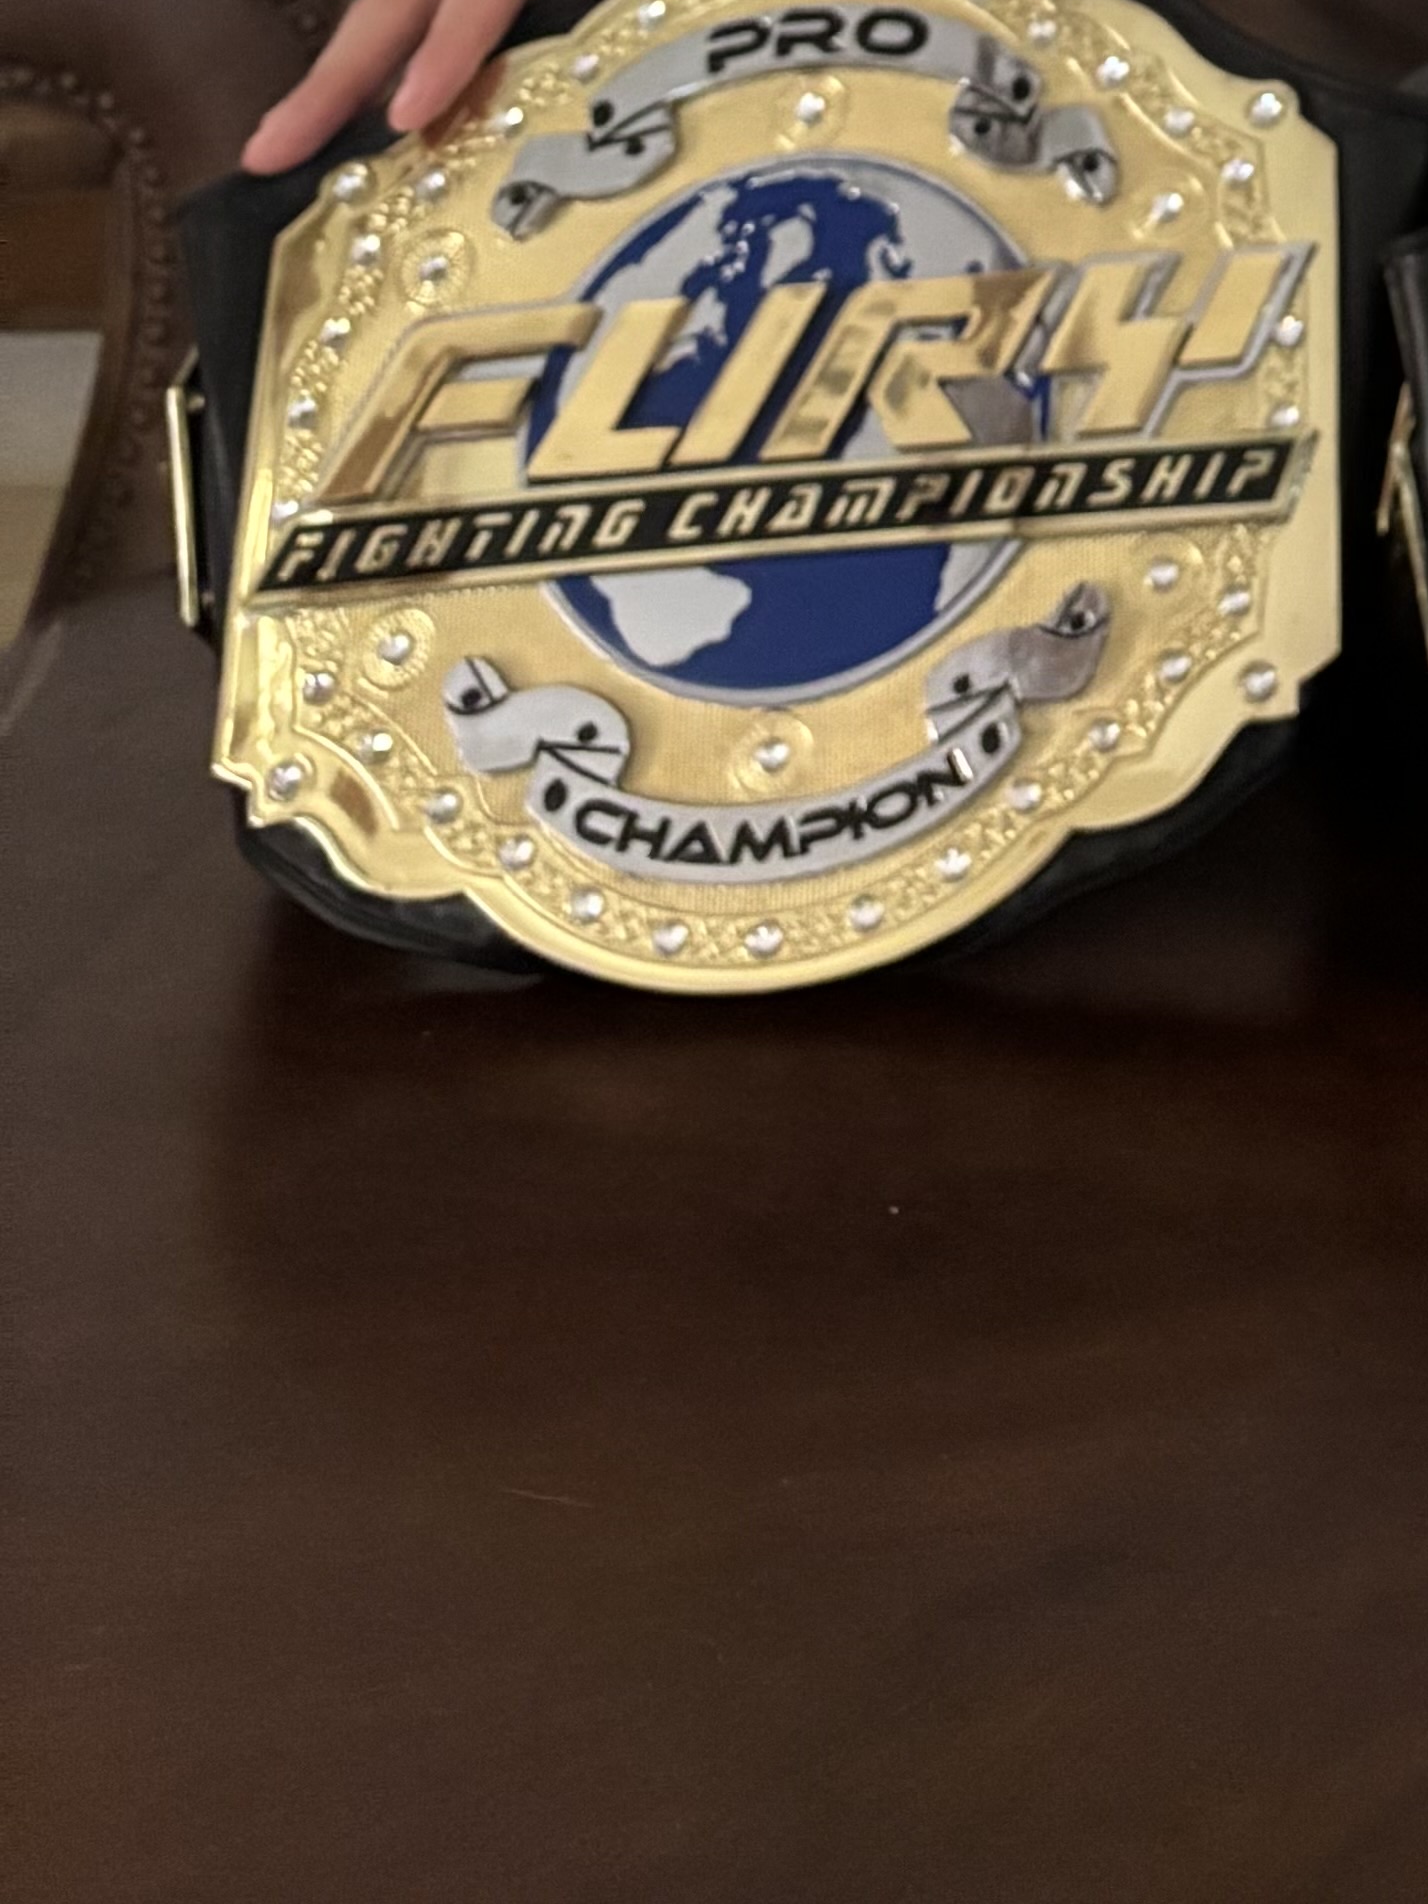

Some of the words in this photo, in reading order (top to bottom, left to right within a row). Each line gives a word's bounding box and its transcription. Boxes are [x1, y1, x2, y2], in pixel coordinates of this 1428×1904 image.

[705, 7, 930, 73] PRO
[312, 241, 1320, 510] FURY
[280, 493, 648, 583] FIGHTING
[666, 445, 1279, 544] CHAMPIONSHIP
[571, 748, 971, 865] CHAMPION
